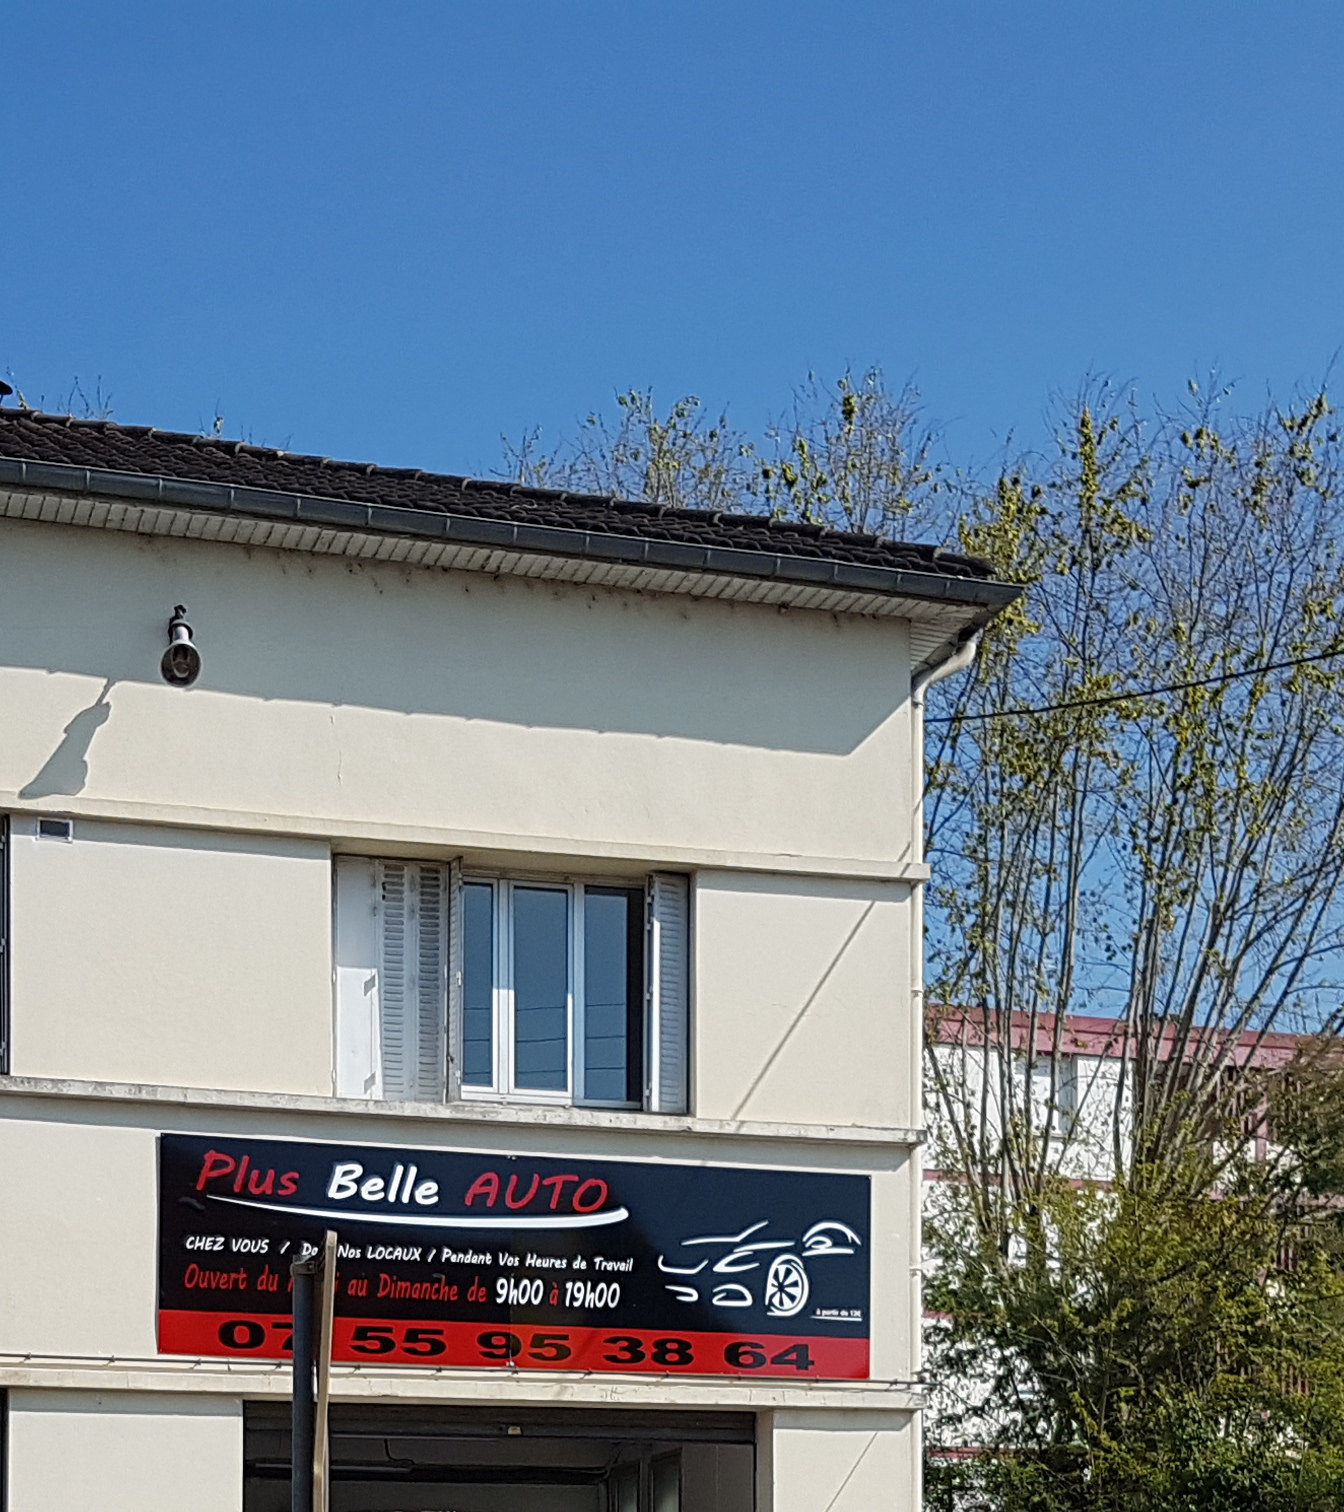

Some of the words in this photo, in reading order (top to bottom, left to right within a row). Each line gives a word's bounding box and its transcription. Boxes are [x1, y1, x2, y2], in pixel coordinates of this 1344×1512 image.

[196, 1150, 300, 1196] Plus
[326, 1161, 439, 1206] Belle
[464, 1171, 609, 1214] AUTO
[185, 1236, 225, 1251] CHEZ
[232, 1238, 270, 1254] VOUS
[337, 1243, 362, 1259] Nos
[367, 1246, 423, 1262] LOCAUX
[441, 1248, 493, 1265] Pendant
[498, 1252, 520, 1267] Vos
[525, 1253, 568, 1269] Heures
[572, 1255, 587, 1270] de
[594, 1257, 634, 1272] Travail
[184, 1263, 249, 1290] Ouvert
[257, 1263, 279, 1292] du
[348, 1277, 369, 1298] au
[377, 1273, 459, 1302] Dimanche
[467, 1275, 488, 1303] de
[495, 1276, 545, 1306] 9h00
[549, 1281, 560, 1306] à
[565, 1280, 621, 1309] 19h00
[348, 1325, 447, 1356] 55
[476, 1330, 573, 1361] 95
[602, 1336, 695, 1366] 38
[723, 1341, 815, 1371] 64
